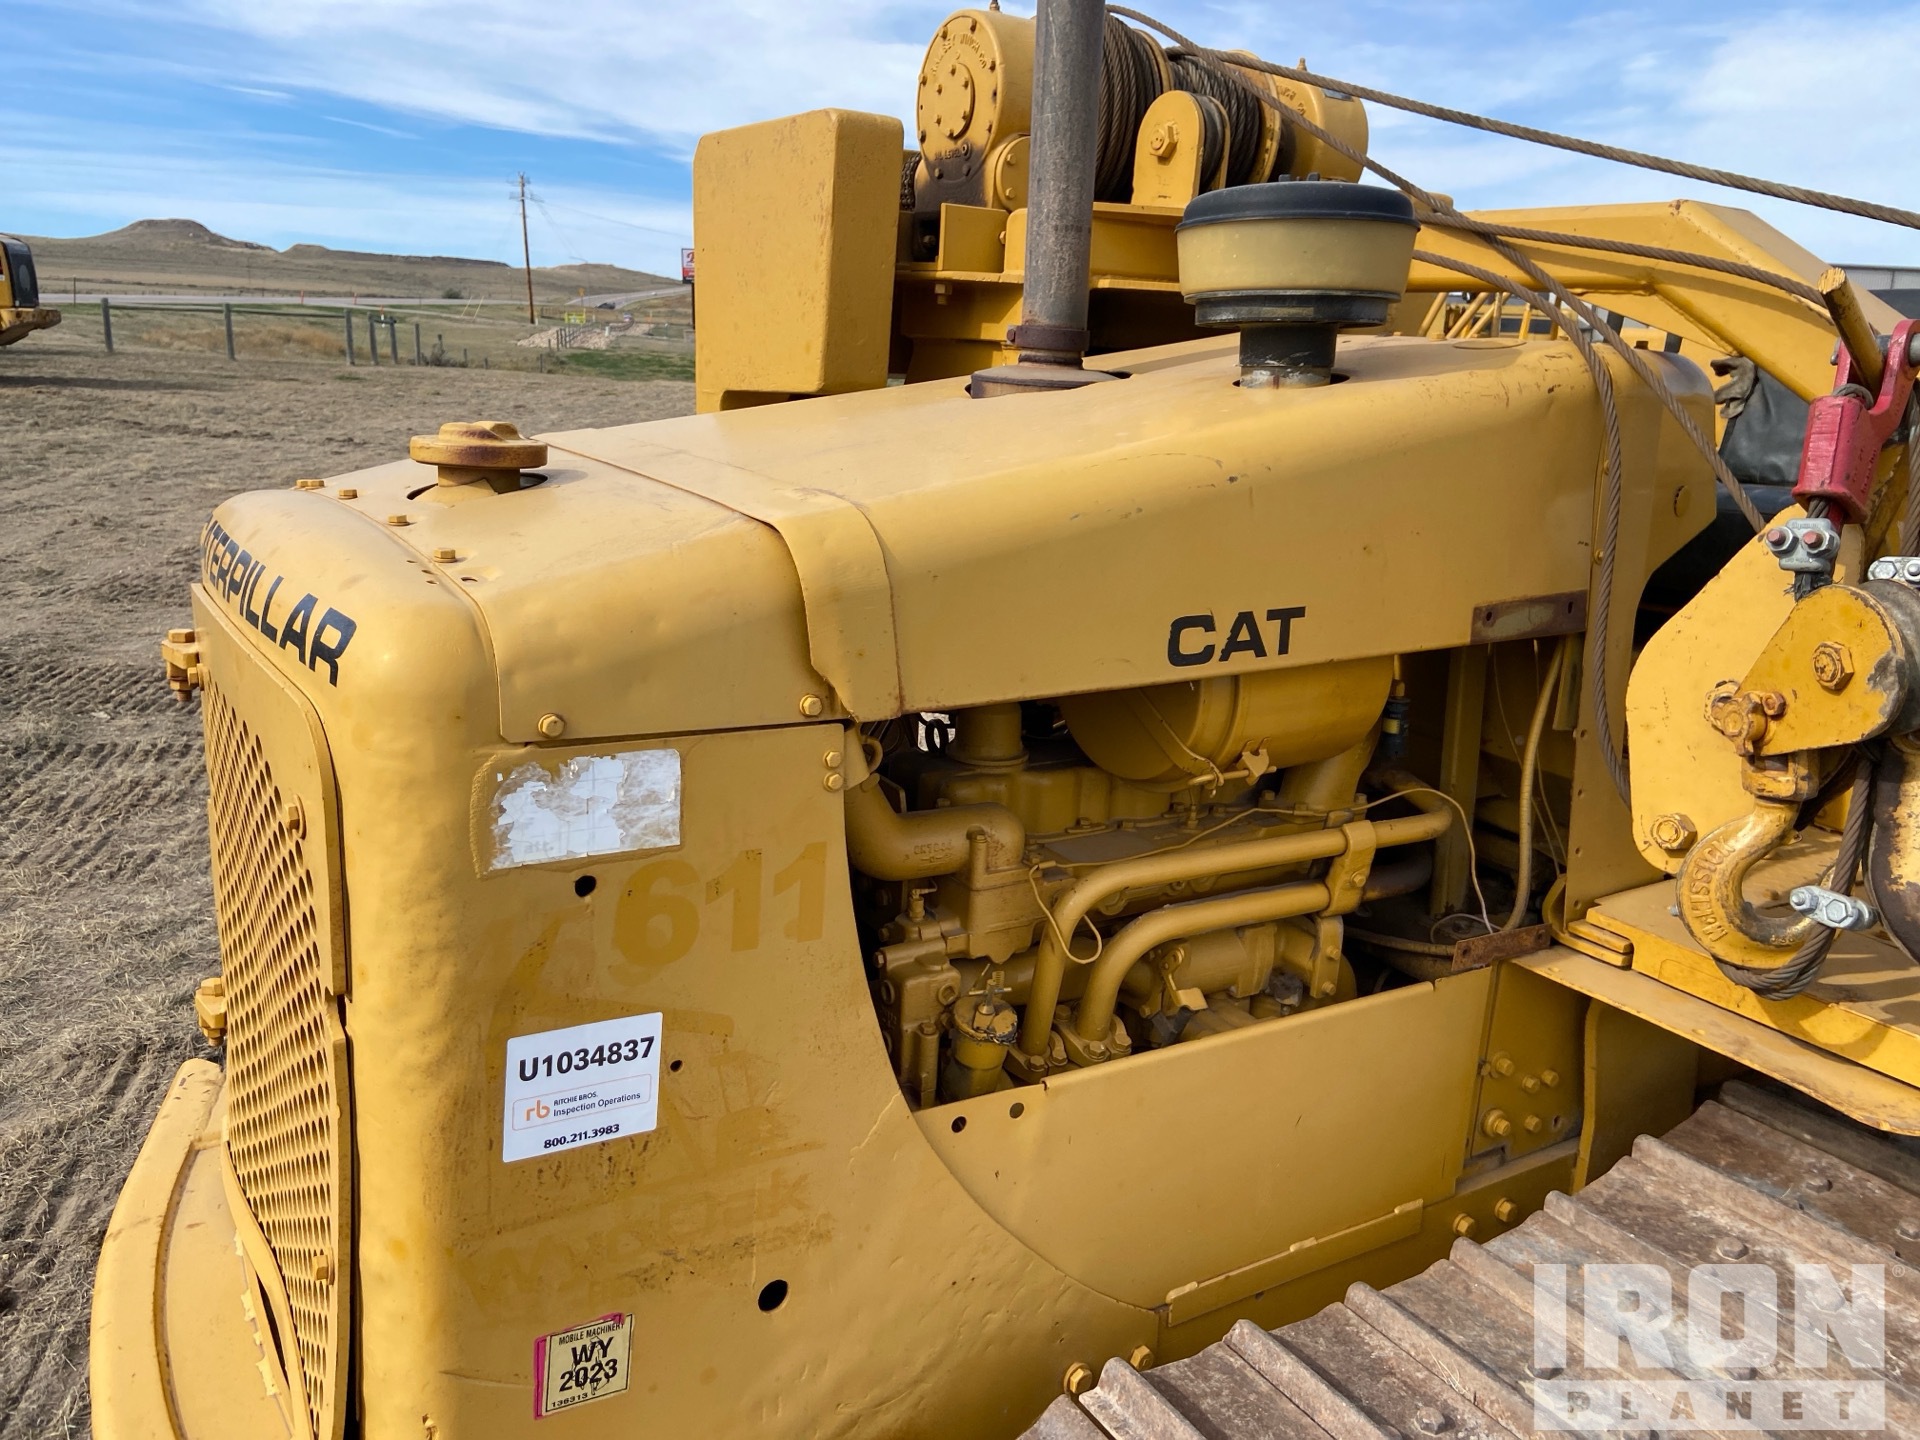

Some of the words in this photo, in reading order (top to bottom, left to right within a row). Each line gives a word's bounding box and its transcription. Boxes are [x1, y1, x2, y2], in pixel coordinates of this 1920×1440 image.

[1168, 606, 1306, 667] CAT
[611, 841, 827, 967] 611
[519, 1036, 655, 1082] U1034837
[526, 1100, 550, 1121] rb
[553, 1095, 578, 1106] RITCHIE
[578, 1091, 598, 1101] BROS.
[553, 1102, 596, 1117] Inspection
[597, 1092, 641, 1107] Operations
[543, 1123, 620, 1149] 800.211.3983
[559, 1331, 584, 1345] MOBILE
[586, 1322, 624, 1338] MACHINERY
[571, 1336, 614, 1366] WY
[559, 1358, 618, 1393] 2023
